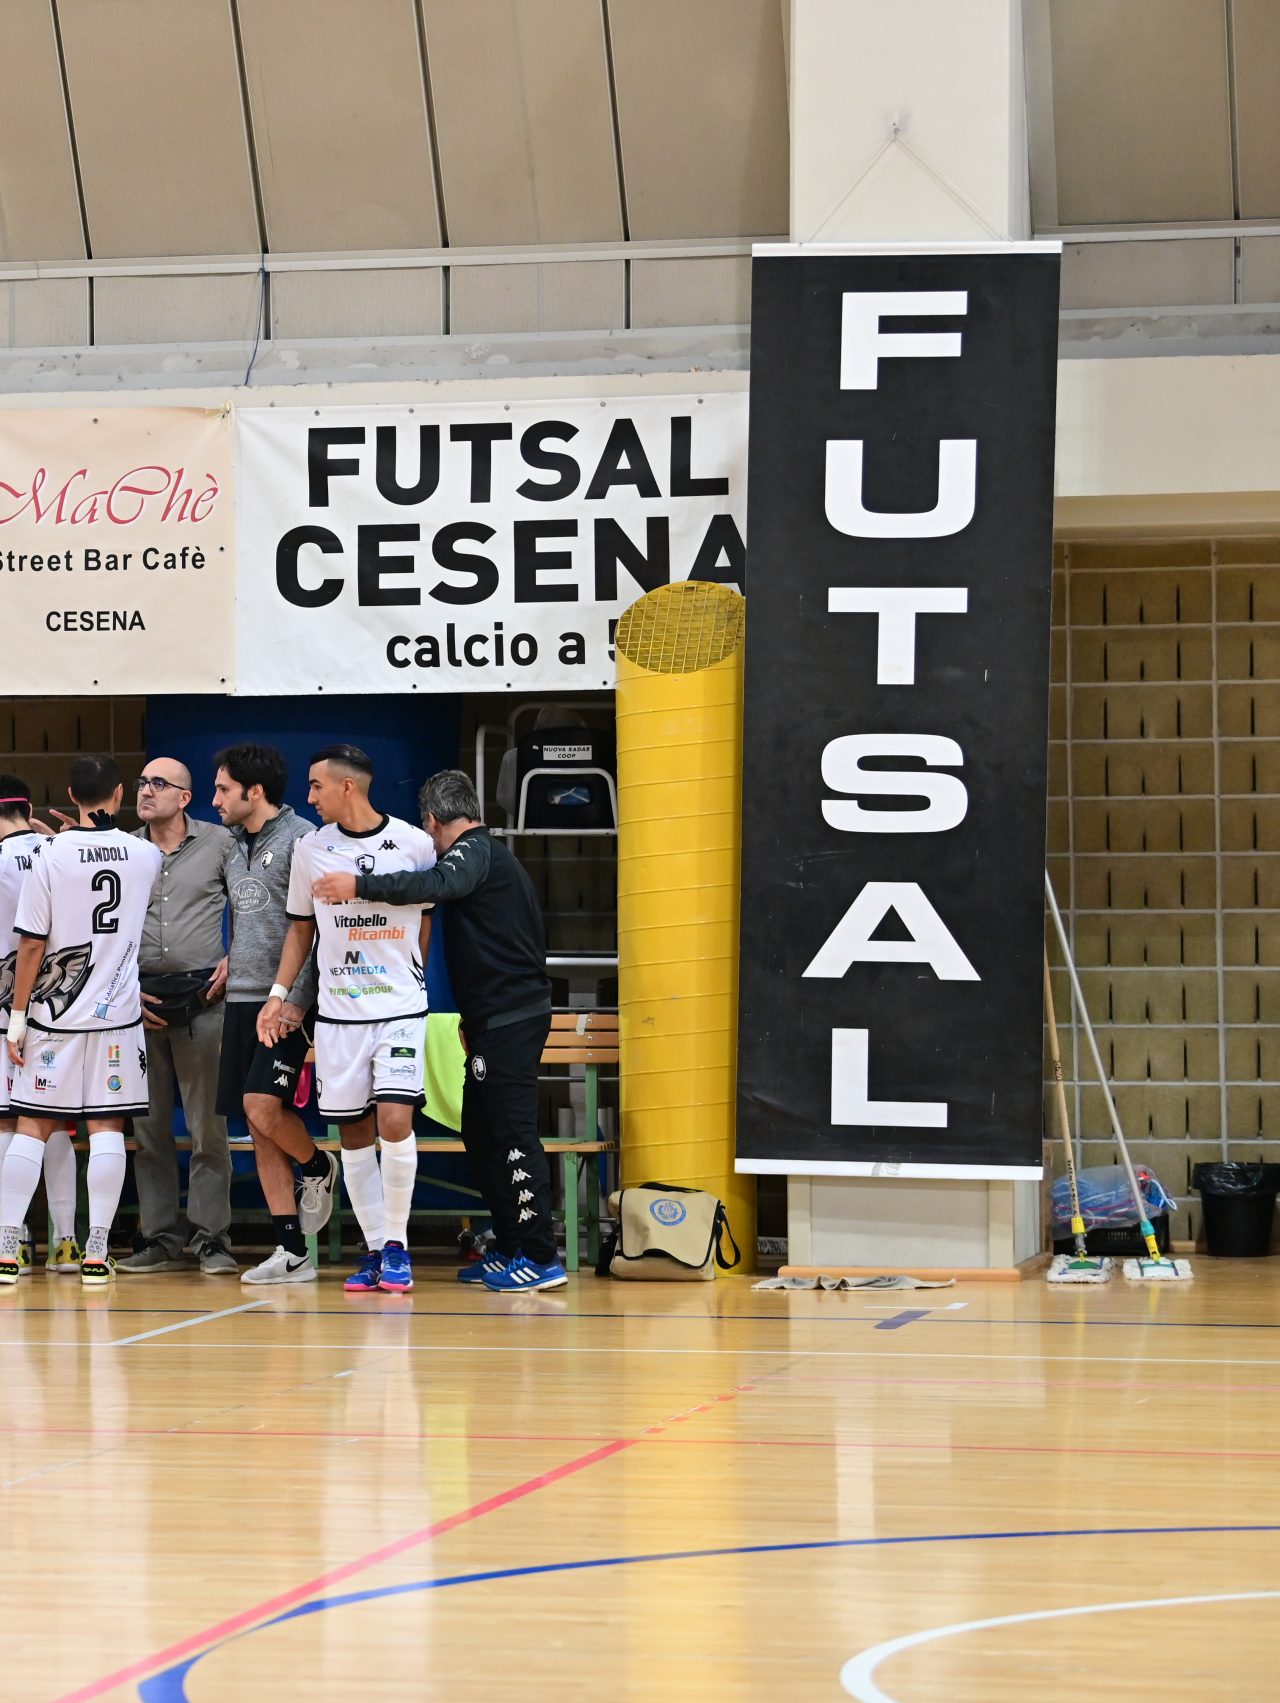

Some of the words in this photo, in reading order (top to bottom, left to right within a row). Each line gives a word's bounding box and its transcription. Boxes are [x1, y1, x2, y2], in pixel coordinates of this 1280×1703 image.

[308, 415, 729, 508] FUTSAL
[83, 547, 131, 572] Bar
[154, 546, 206, 571] Cafè
[275, 514, 747, 608] CESENA
[45, 610, 146, 632] CESENA
[385, 621, 539, 669] calcio
[557, 631, 586, 666] a
[801, 291, 982, 1128] FUTSAL
[78, 846, 129, 863] ZANDOLI
[91, 869, 121, 934] 2
[334, 914, 387, 928] Vitobello
[348, 926, 406, 941] Ricambi
[329, 965, 387, 976] NEXTMEDIA
[362, 984, 394, 996] GROUP
